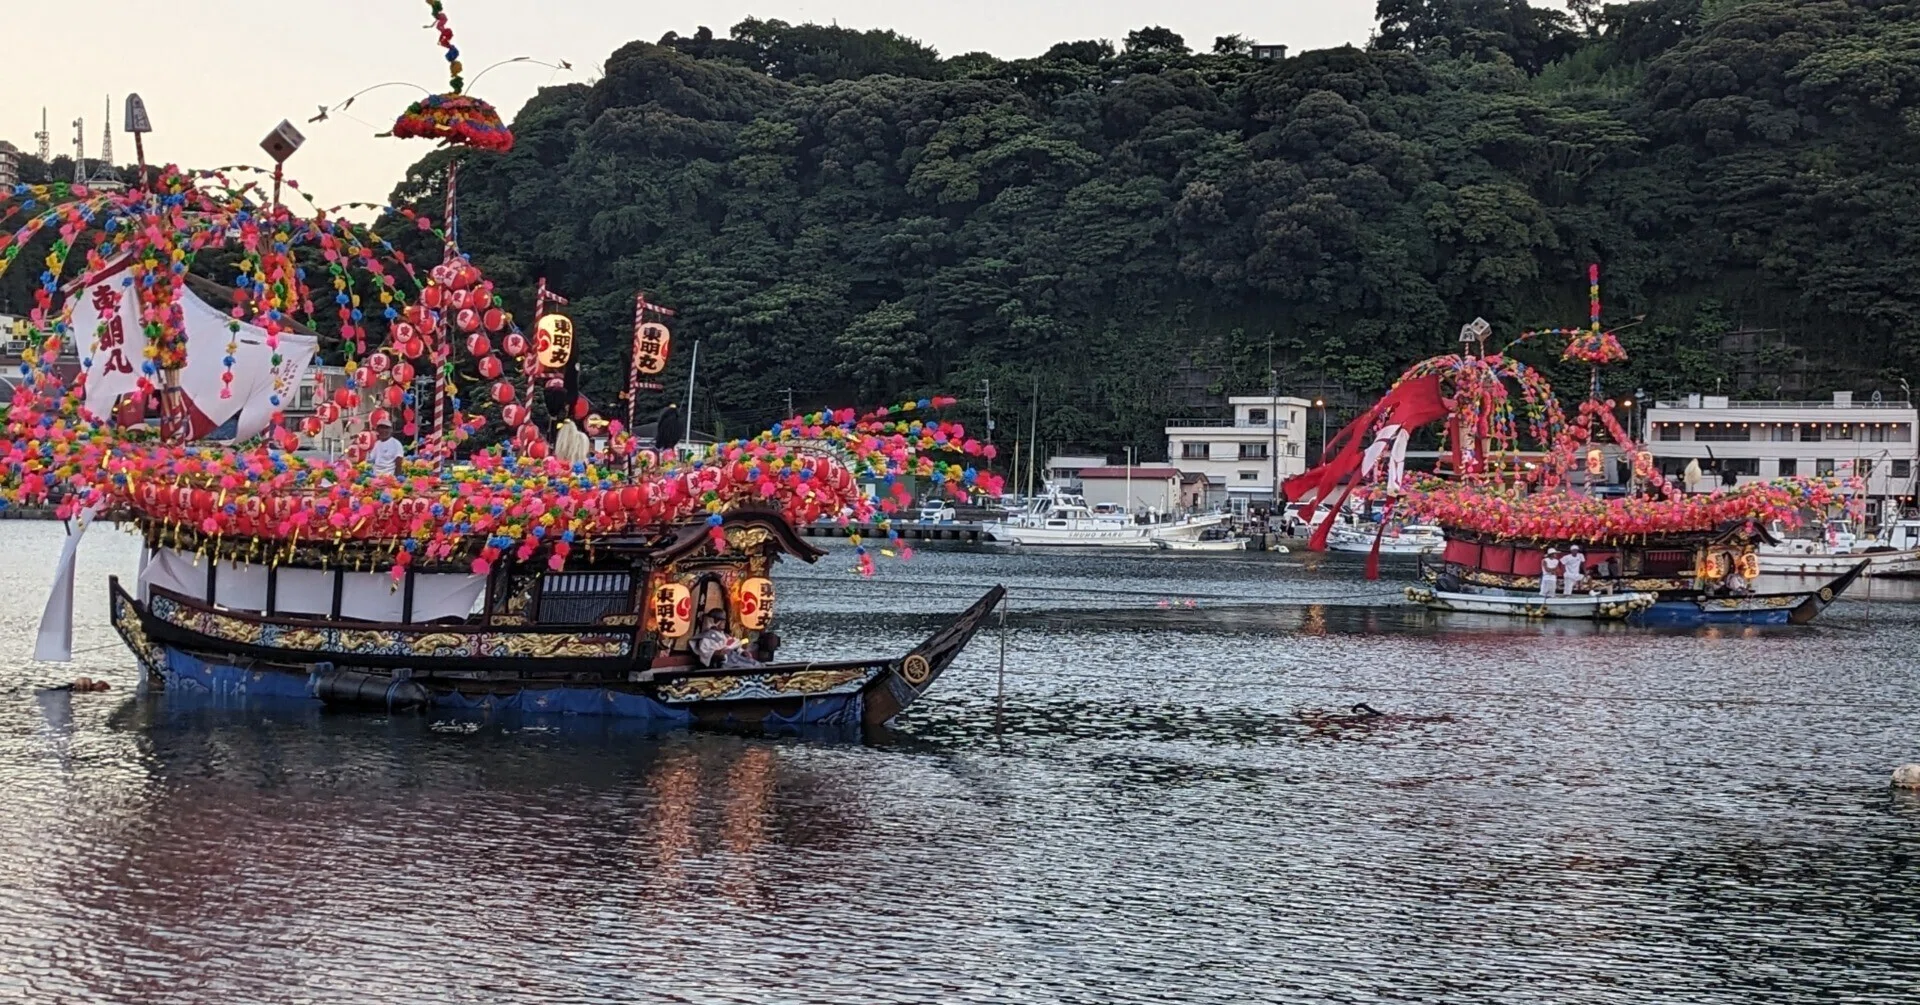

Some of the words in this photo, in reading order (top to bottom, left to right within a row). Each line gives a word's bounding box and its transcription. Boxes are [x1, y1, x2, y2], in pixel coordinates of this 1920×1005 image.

[92, 285, 133, 376] 東明丸
[549, 319, 571, 364] 東明丸
[639, 327, 661, 370] 東明丸
[657, 587, 676, 633] 東明丸
